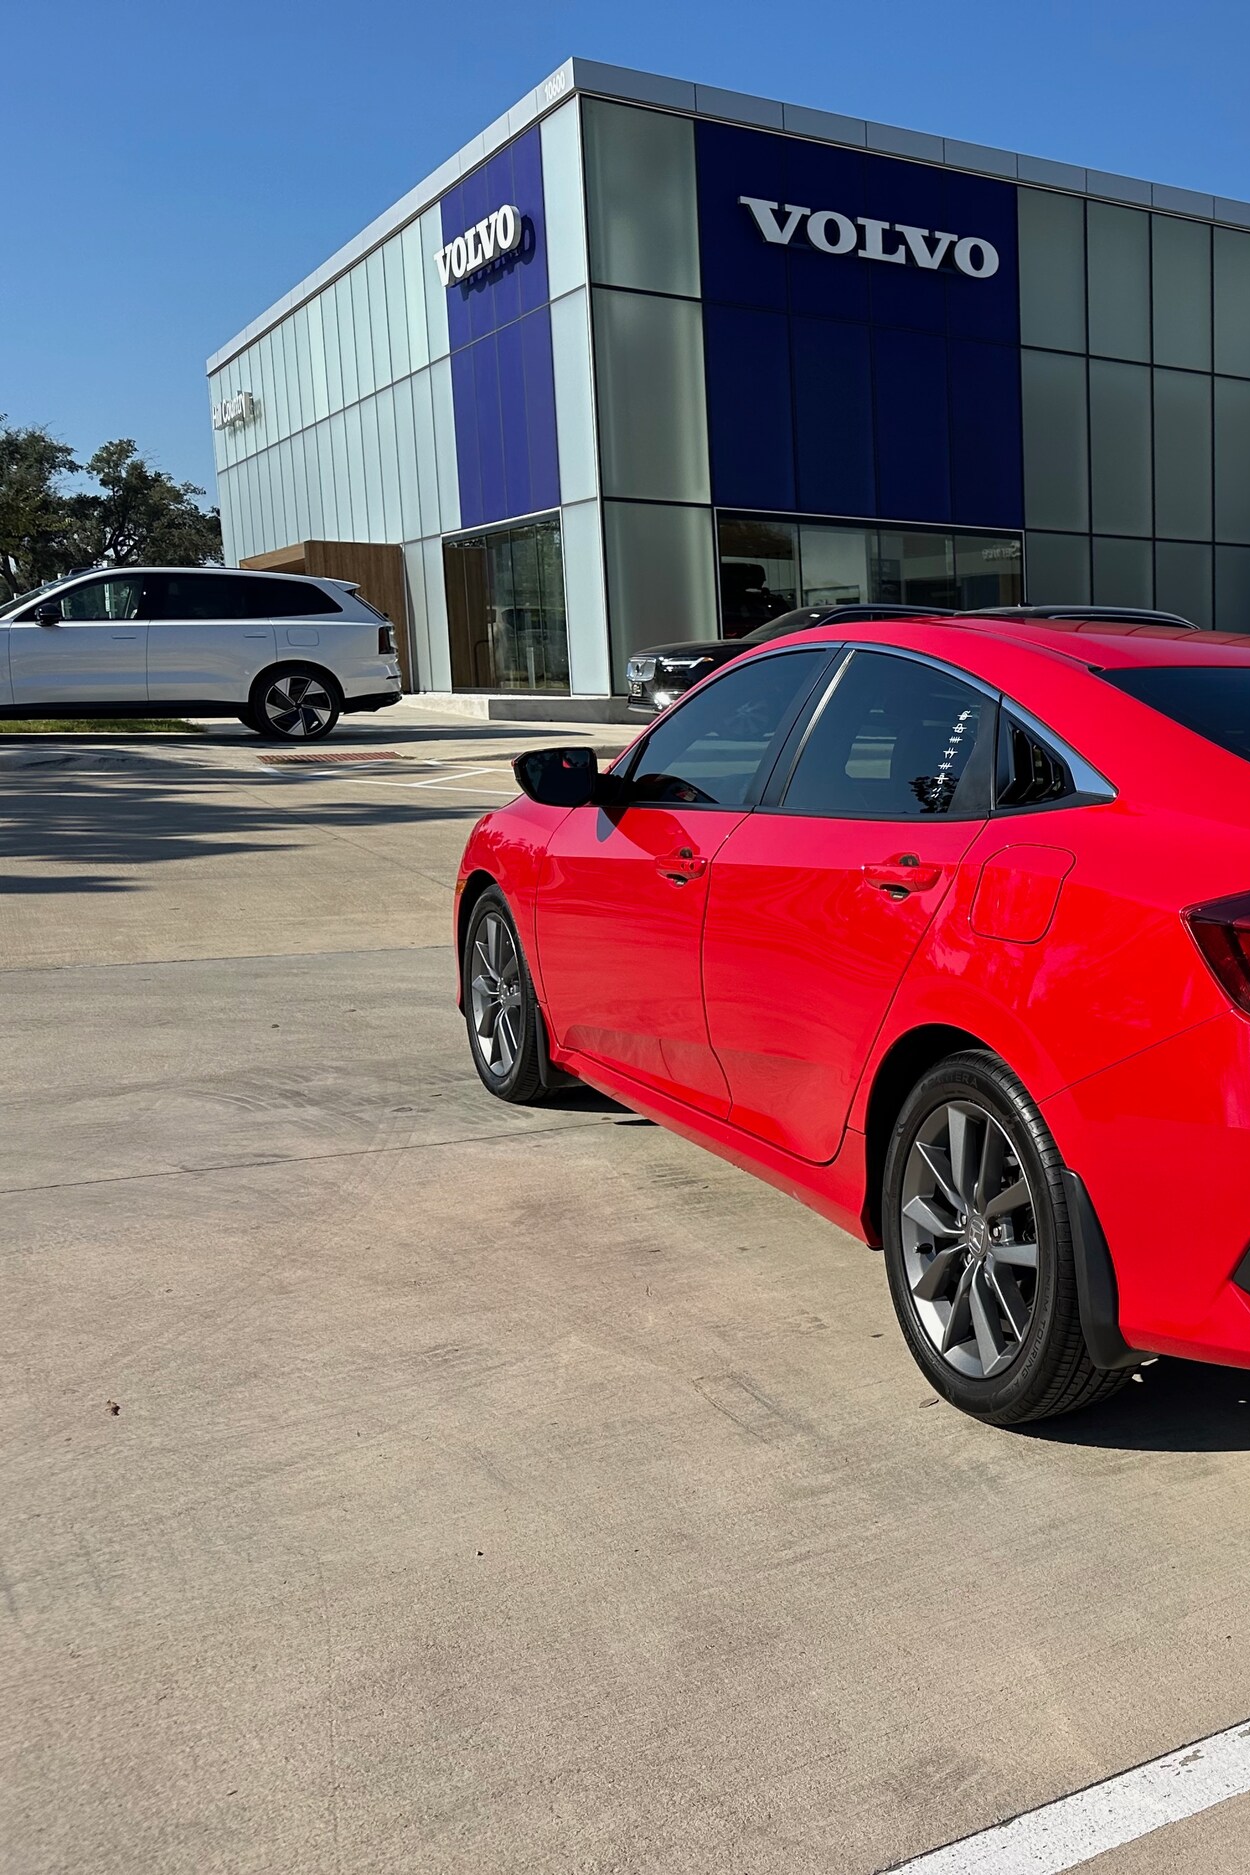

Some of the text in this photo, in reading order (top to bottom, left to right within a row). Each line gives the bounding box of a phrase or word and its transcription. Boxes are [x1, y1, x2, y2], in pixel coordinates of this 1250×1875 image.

[433, 204, 519, 288] VOLVO
[738, 196, 999, 278] VOLVO
[1021, 1320, 1046, 1379] TOURING
